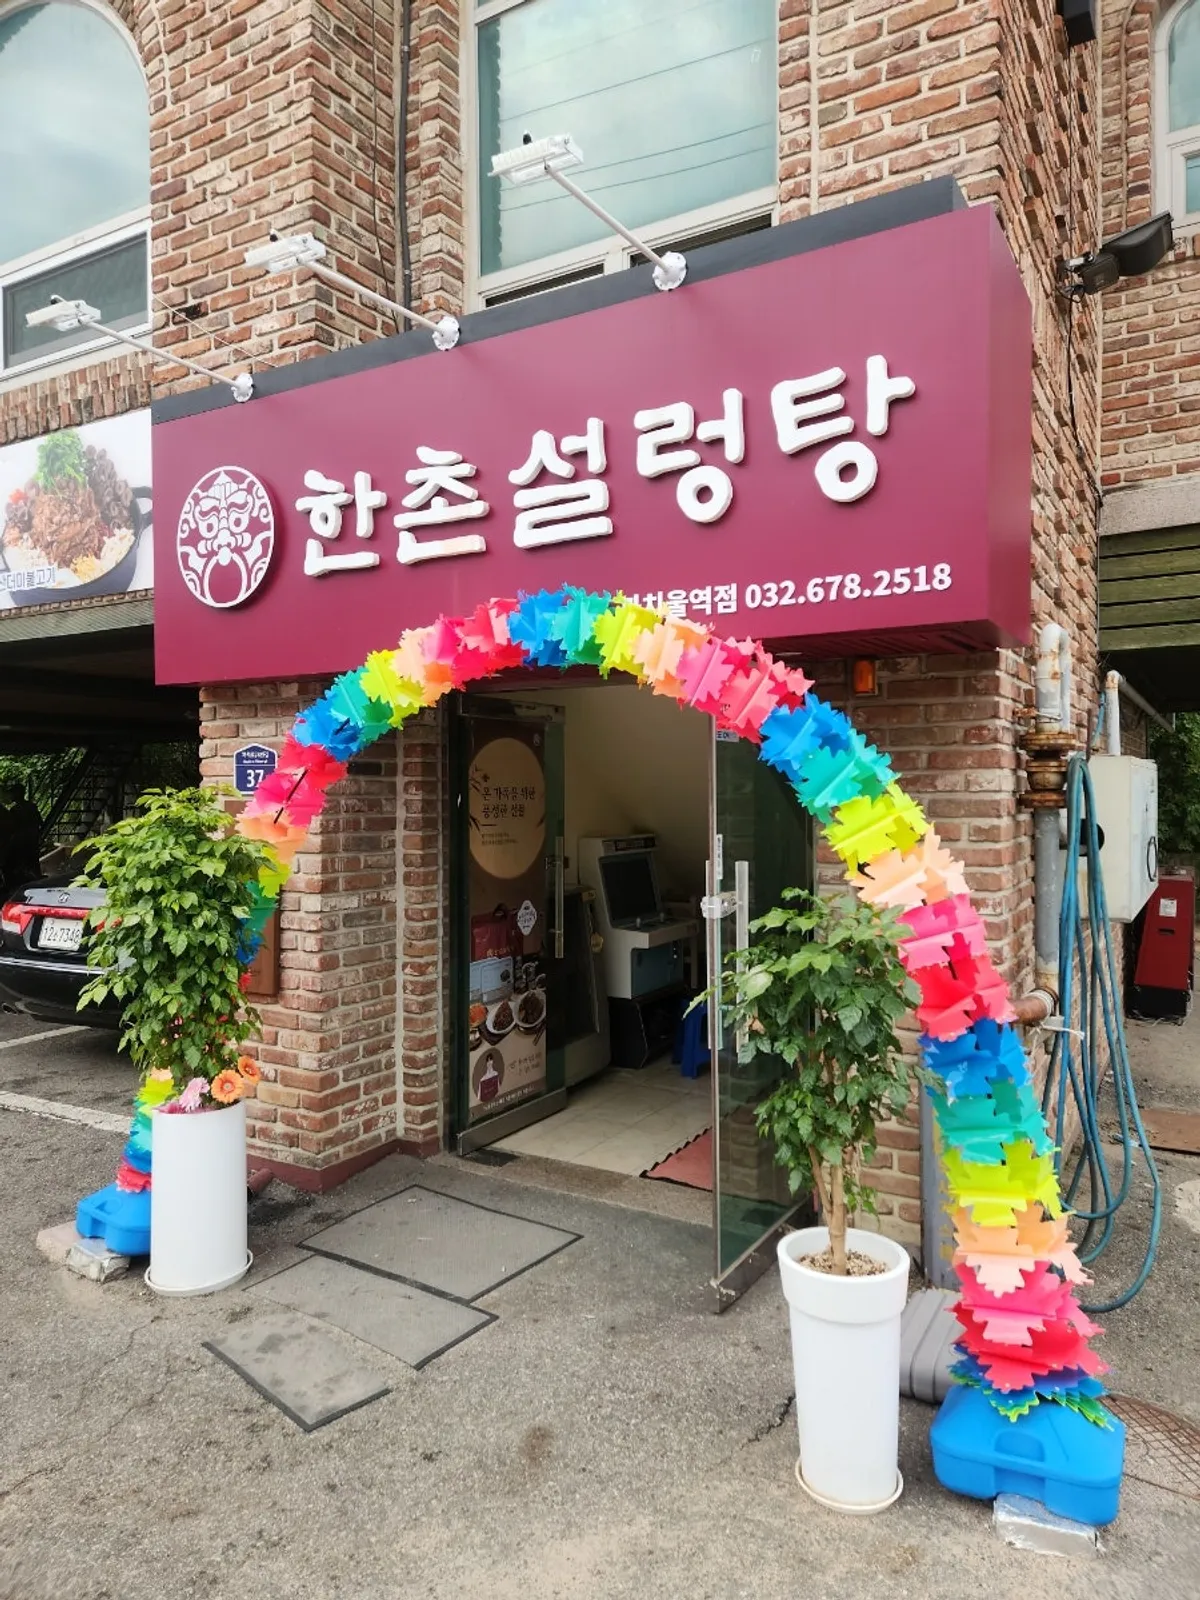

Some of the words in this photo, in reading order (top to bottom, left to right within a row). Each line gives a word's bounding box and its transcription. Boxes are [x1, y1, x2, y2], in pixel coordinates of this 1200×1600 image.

[295, 354, 916, 576] 한촌설렁탕
[745, 562, 952, 609] 032.678.2518
[246, 769, 264, 788] 37
